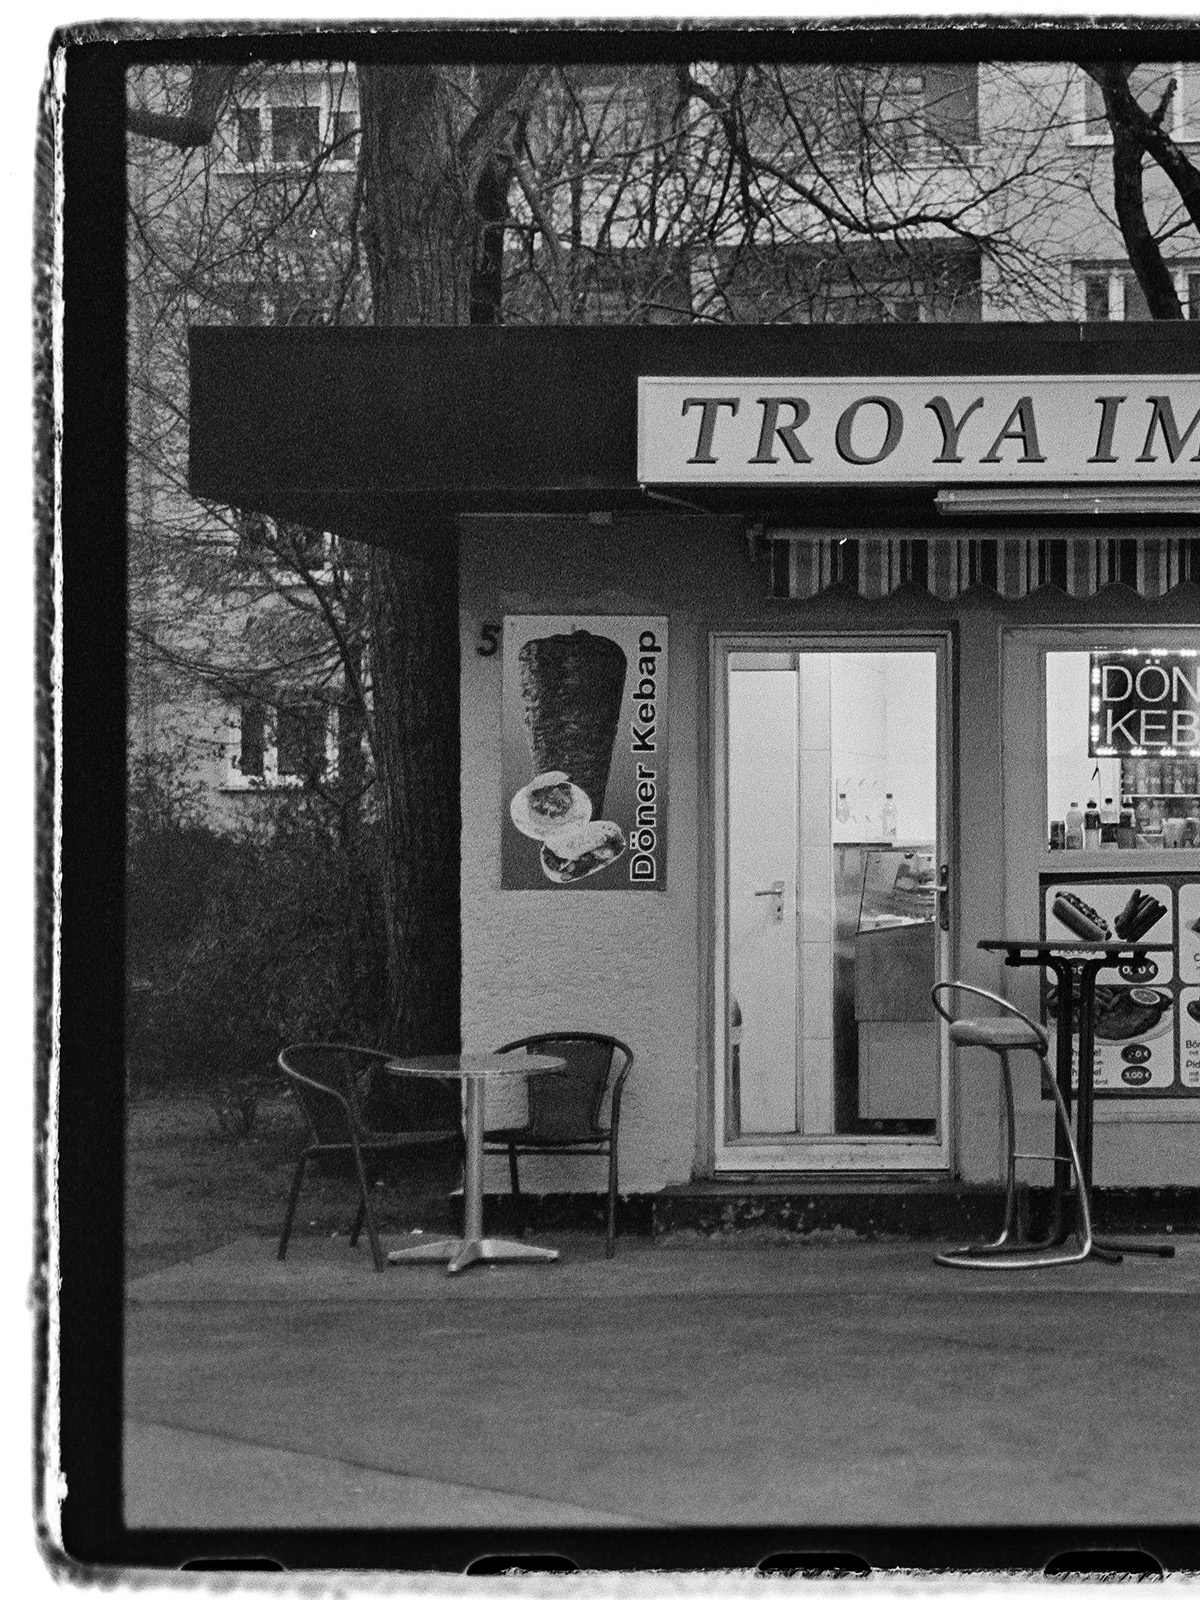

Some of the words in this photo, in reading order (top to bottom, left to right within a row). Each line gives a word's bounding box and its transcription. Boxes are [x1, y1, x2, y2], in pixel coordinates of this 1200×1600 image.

[681, 395, 1047, 465] TROYA
[632, 630, 662, 752] Kebap
[630, 762, 656, 881] Döner
